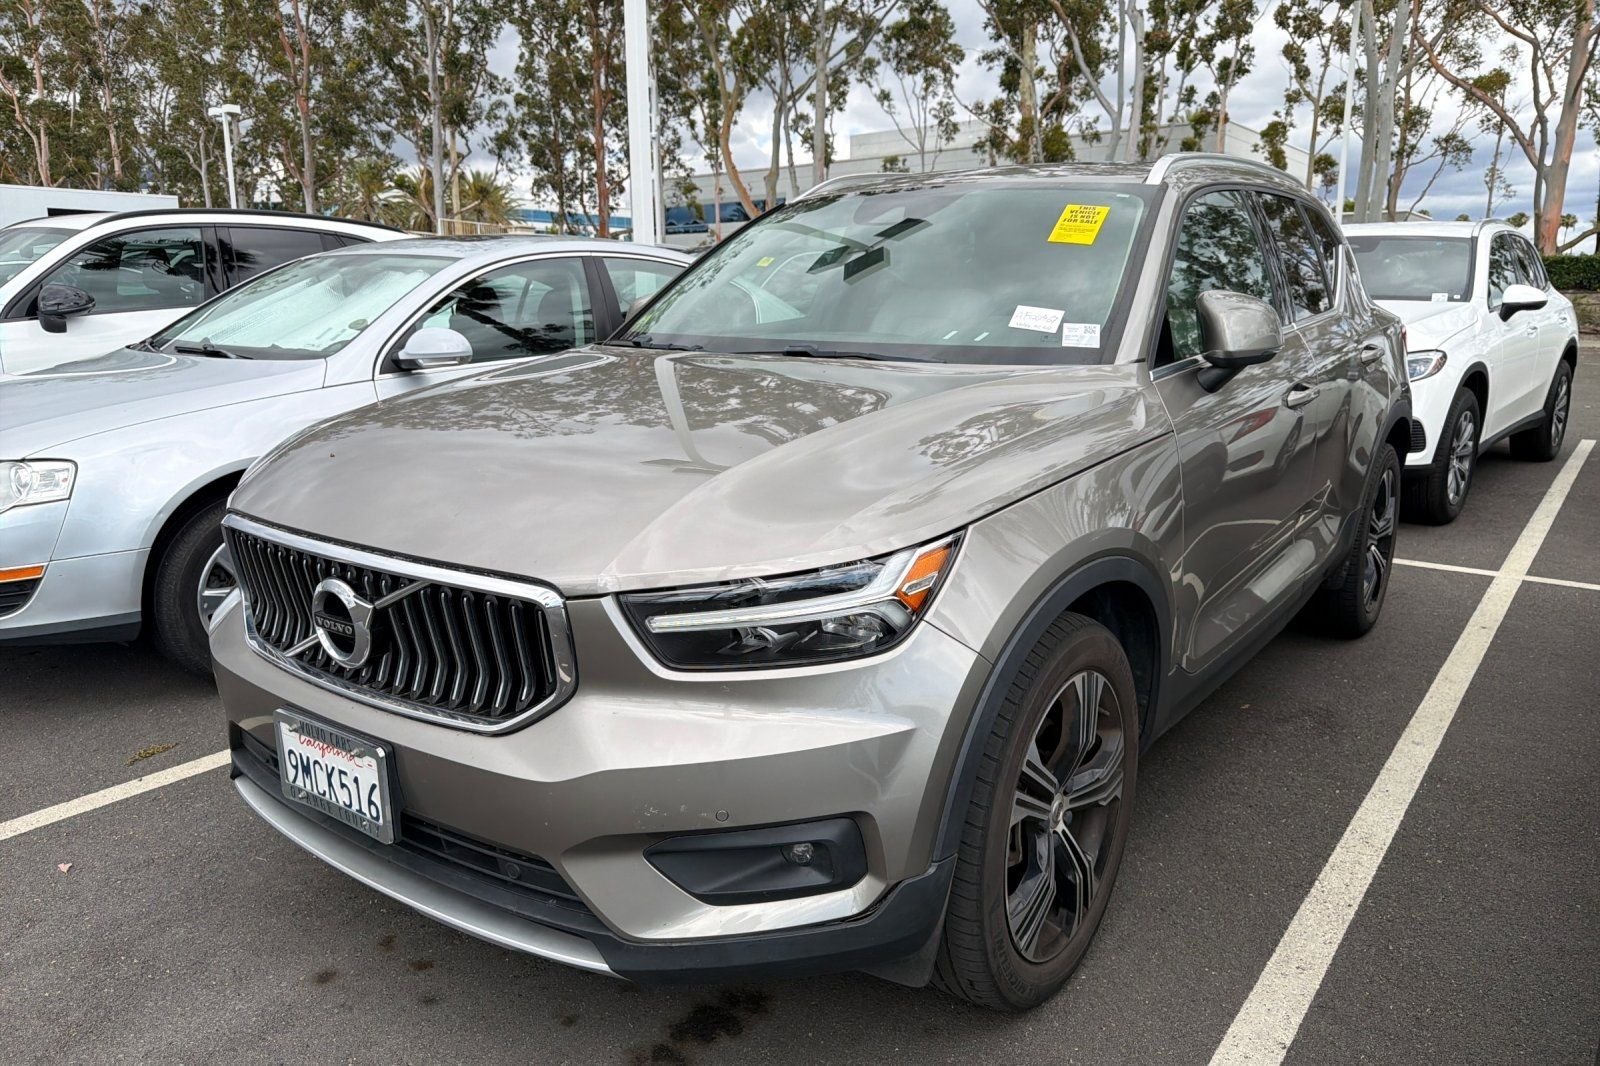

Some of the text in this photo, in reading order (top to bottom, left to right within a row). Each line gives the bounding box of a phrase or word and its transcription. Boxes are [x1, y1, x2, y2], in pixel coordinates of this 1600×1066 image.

[315, 616, 353, 635] VOLVO
[299, 720, 353, 753] VOLVO CARS
[287, 748, 381, 822] 9MCK516
